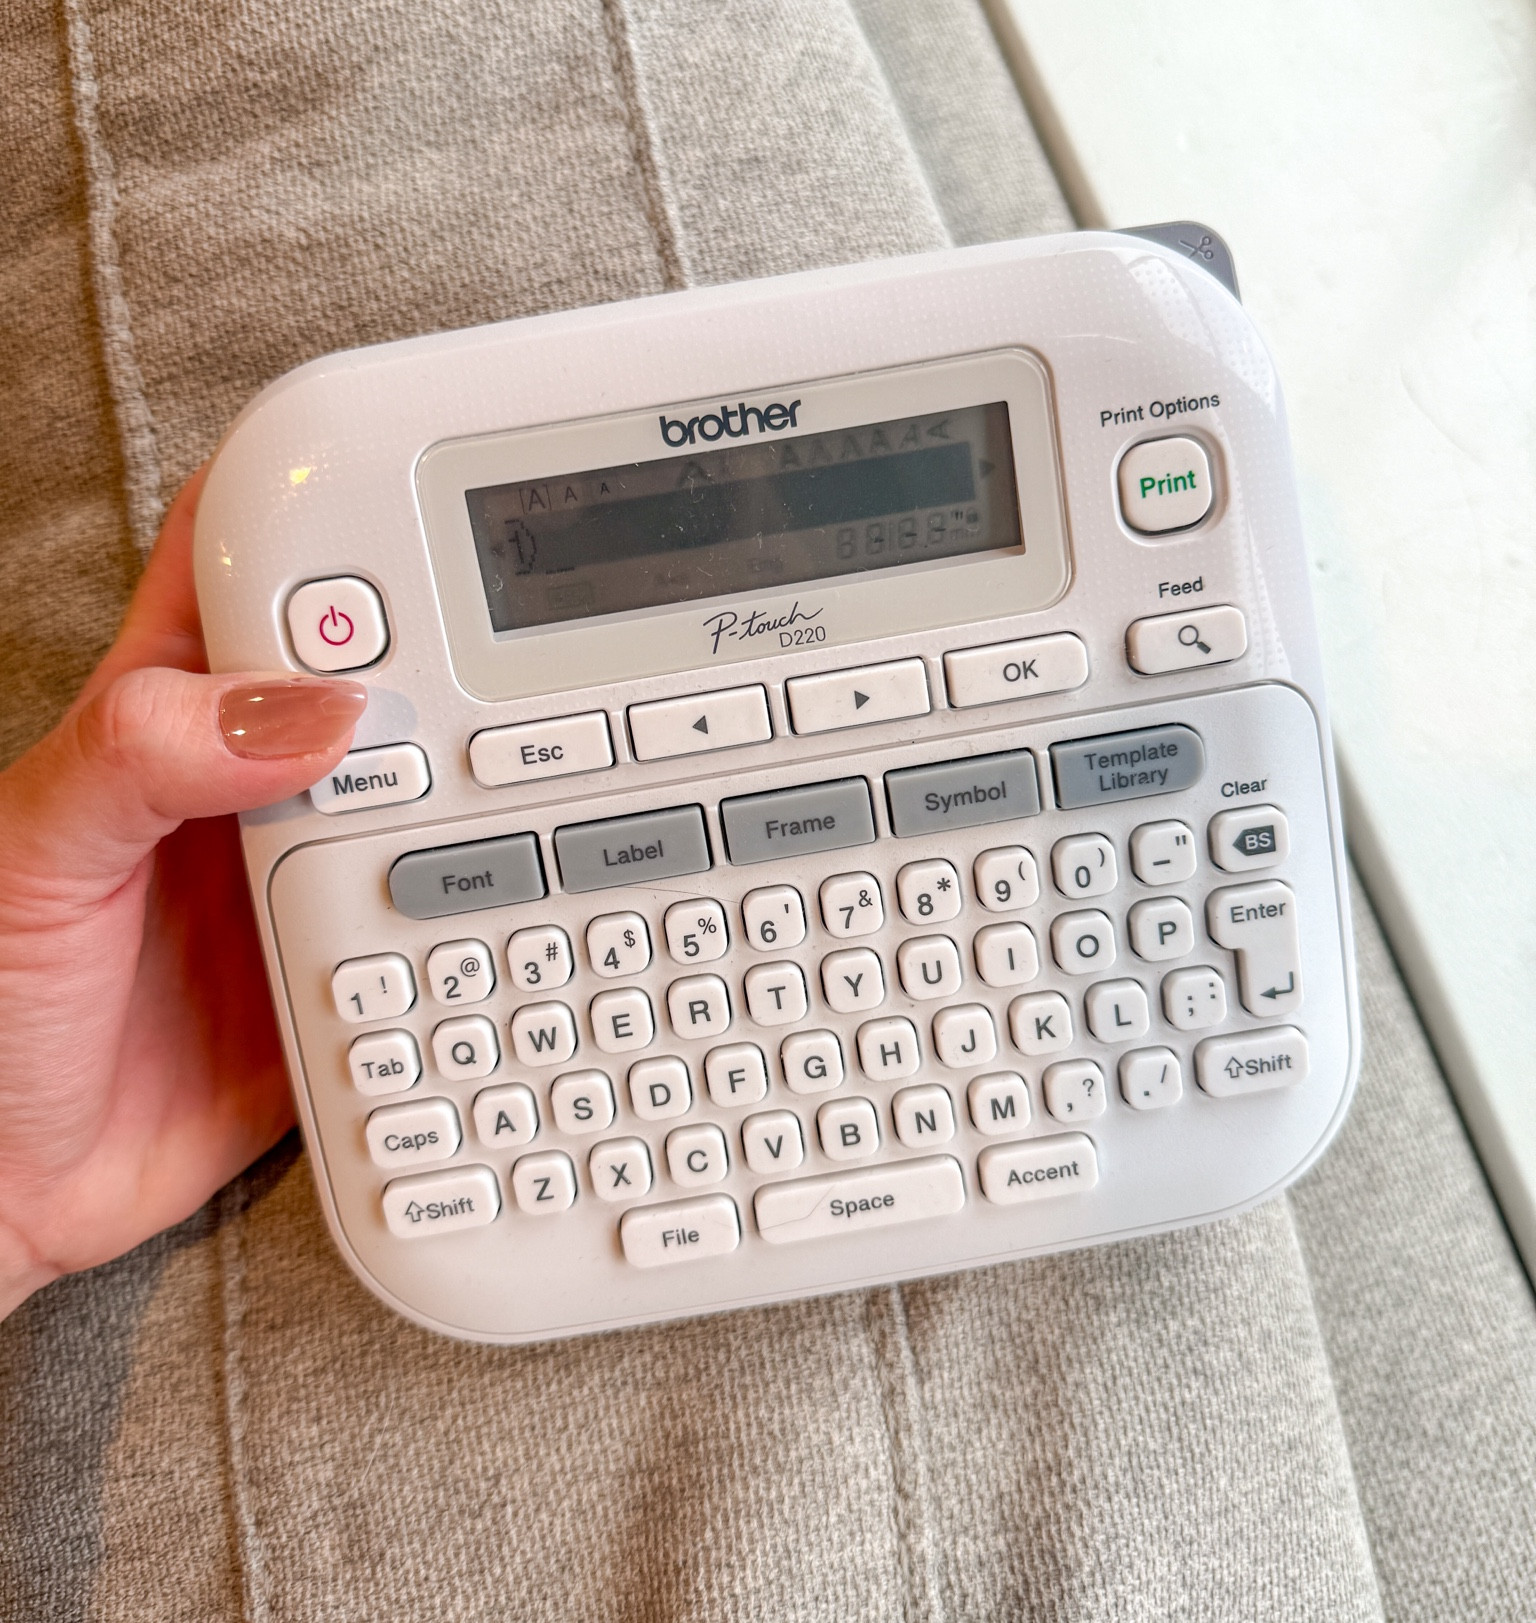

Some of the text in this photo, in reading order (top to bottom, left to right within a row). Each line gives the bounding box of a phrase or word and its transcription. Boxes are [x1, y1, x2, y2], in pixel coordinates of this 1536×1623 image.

[658, 399, 802, 448] brother
[1100, 394, 1220, 428] Print Options
[1139, 470, 1197, 499] Print
[1158, 575, 1204, 599] Feed
[702, 601, 824, 654] P-touch
[775, 621, 826, 648] D220
[1002, 658, 1039, 683] OK
[520, 744, 564, 766] Esc
[1083, 740, 1179, 770] Template
[332, 771, 398, 796] Menu
[1098, 764, 1169, 792] Library
[1220, 778, 1268, 798] Clear
[924, 780, 1007, 814] Symbol
[765, 815, 836, 840] Frame
[602, 839, 664, 867] Label
[1244, 831, 1271, 851] BS
[441, 870, 495, 895] Font
[1074, 865, 1091, 889] 0
[994, 879, 1012, 903] 9
[838, 889, 874, 930] 7 &
[916, 892, 934, 917] 8
[1230, 902, 1286, 924] Enter
[683, 916, 717, 957] 5 %
[760, 920, 778, 944] 6
[1157, 920, 1177, 946] P
[603, 928, 636, 970] 4 $
[1007, 947, 1015, 971] I
[1075, 934, 1100, 959] O
[524, 941, 559, 985] 3 #
[921, 959, 943, 985] U
[443, 956, 481, 1000] 2 @
[843, 972, 864, 998] Y
[350, 992, 364, 1015] 1
[766, 985, 786, 1010] T
[688, 999, 712, 1025] R
[1114, 1003, 1133, 1027] L
[611, 1013, 634, 1039] E
[1034, 1015, 1057, 1041] K
[527, 1026, 557, 1053] W
[961, 1028, 977, 1053] J
[451, 1041, 477, 1066] Q
[879, 1041, 902, 1067] H
[1245, 1054, 1292, 1076] Shift
[360, 1058, 405, 1079] Tab
[803, 1055, 828, 1080] G
[728, 1068, 746, 1094] F
[1082, 1078, 1095, 1097] ?
[649, 1083, 672, 1108] D
[990, 1095, 1016, 1121] M
[572, 1096, 594, 1121] S
[494, 1110, 517, 1136] A
[914, 1109, 937, 1134] N
[384, 1130, 439, 1152] Caps
[763, 1134, 783, 1159] V
[839, 1123, 862, 1147] B
[686, 1149, 709, 1173] C
[1007, 1160, 1080, 1187] Accent
[610, 1162, 632, 1188] X
[533, 1177, 555, 1202] Z
[425, 1197, 475, 1220] Shift
[829, 1194, 895, 1219] Space
[662, 1228, 700, 1248] File
